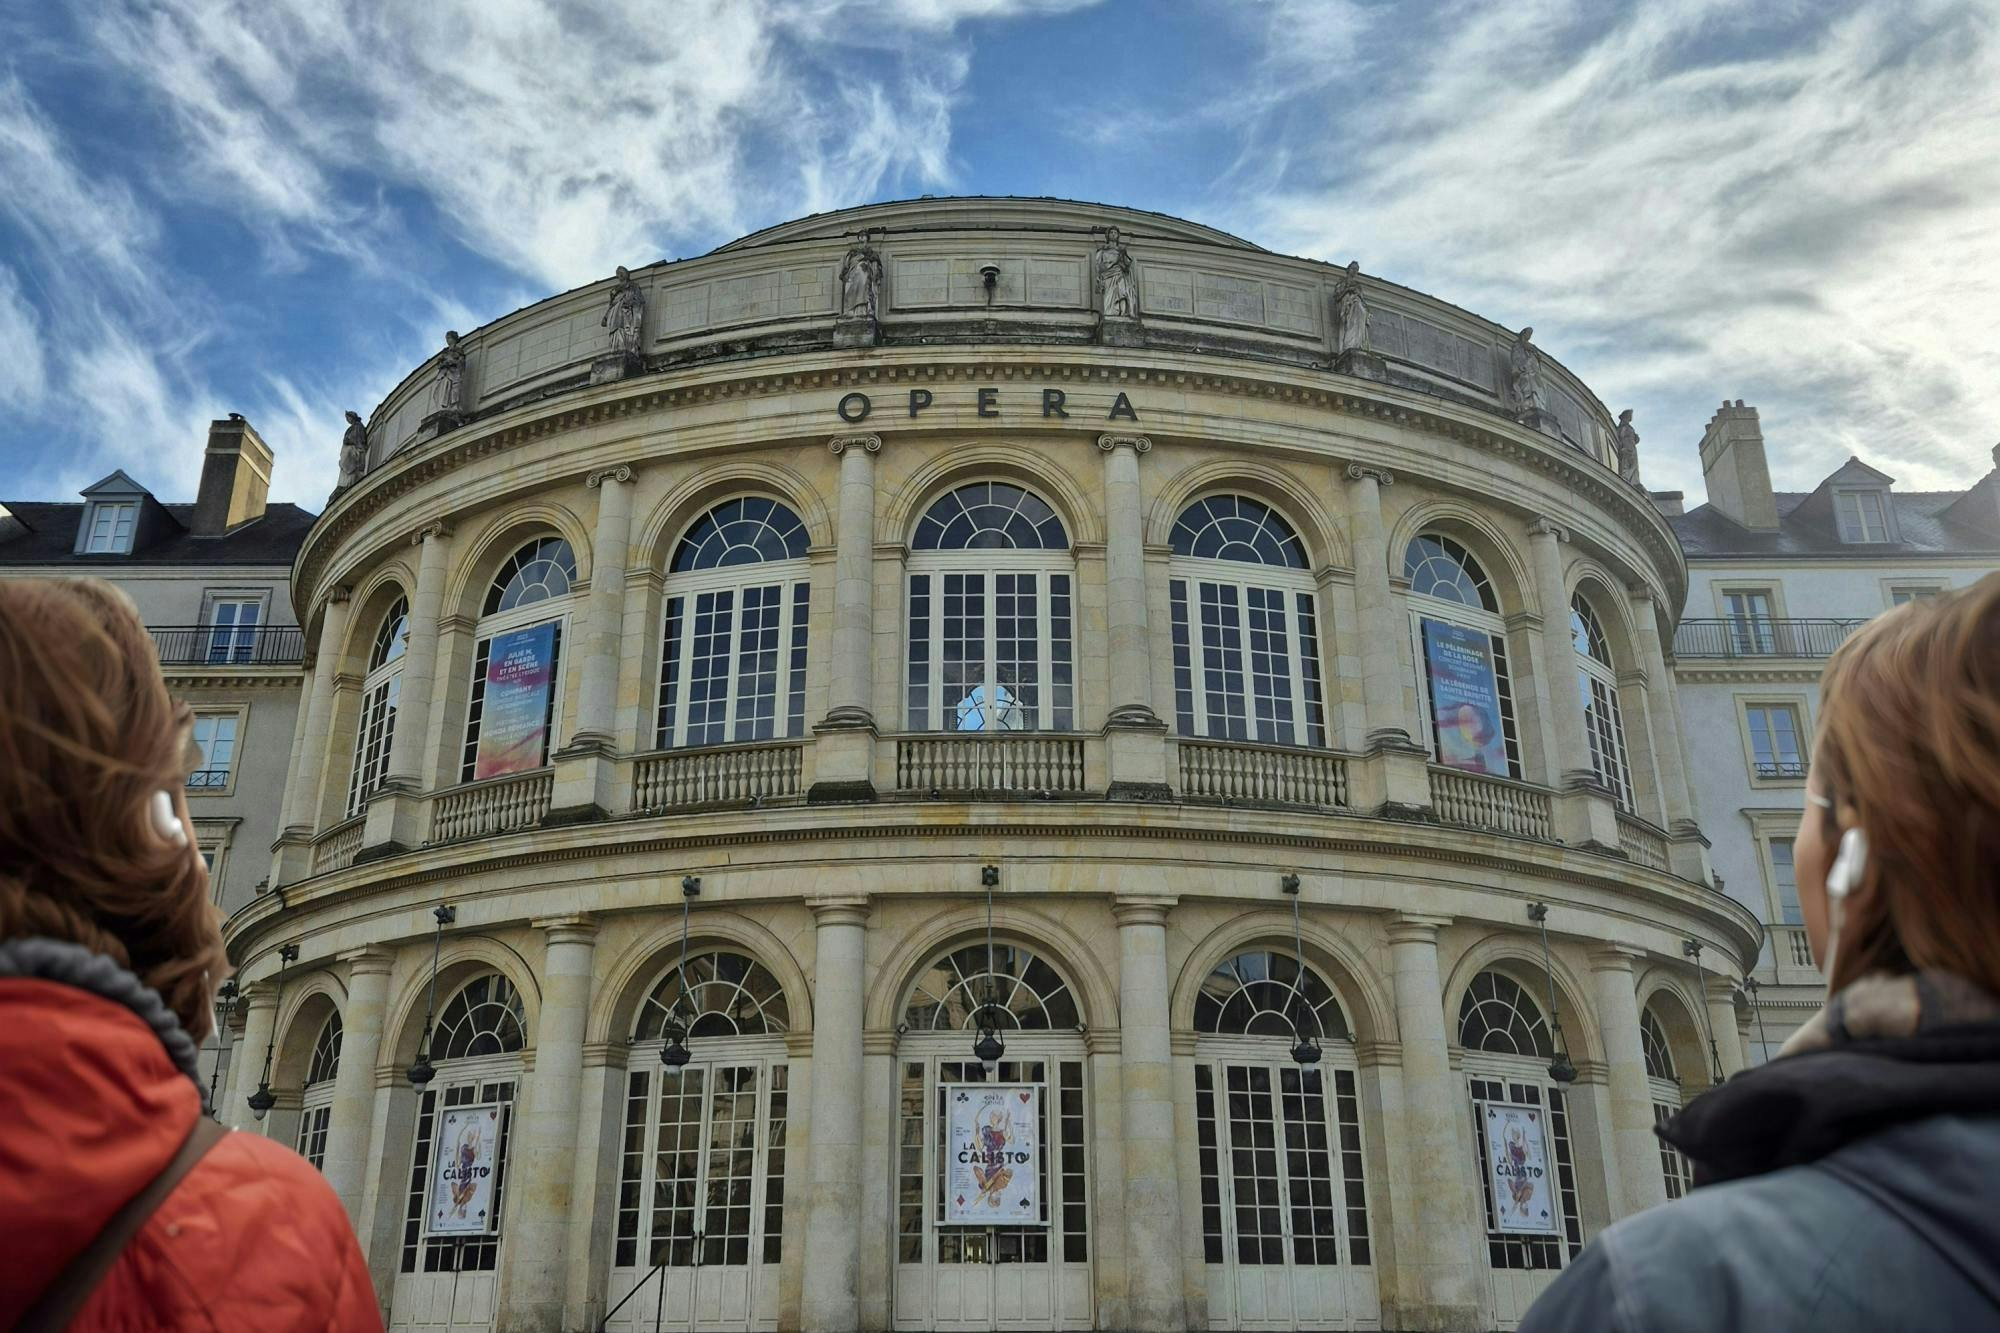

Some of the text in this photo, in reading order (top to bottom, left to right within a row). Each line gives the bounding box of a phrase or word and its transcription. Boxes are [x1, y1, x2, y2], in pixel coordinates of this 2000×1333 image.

[838, 388, 1138, 423] OPERA
[1453, 651, 1462, 659] LA
[504, 660, 513, 668] EN
[507, 666, 517, 674] EN
[963, 1142, 976, 1150] LA
[958, 1151, 1030, 1164] CALISTO
